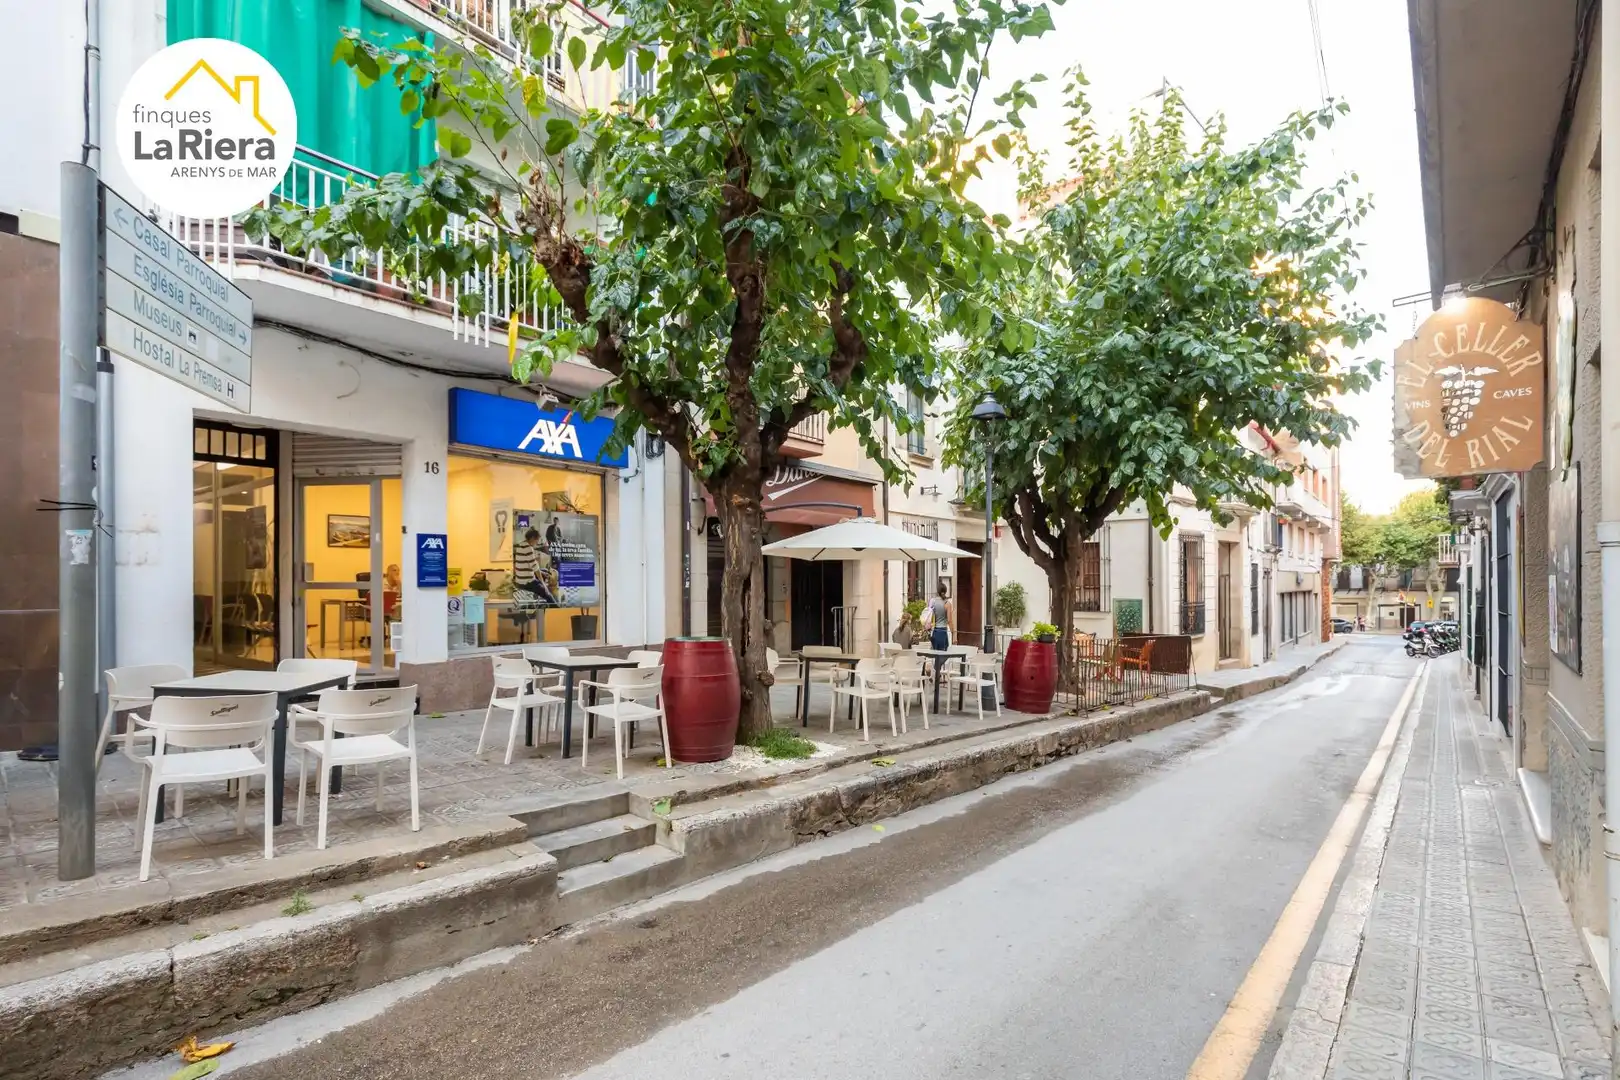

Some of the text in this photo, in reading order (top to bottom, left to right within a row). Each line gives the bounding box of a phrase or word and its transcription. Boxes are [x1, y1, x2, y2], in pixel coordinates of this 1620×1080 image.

[133, 216, 229, 302] Casal Parroquial
[133, 290, 183, 337] Museus
[189, 292, 236, 337] Parroquial
[133, 328, 174, 368] Hostal
[179, 353, 190, 377] La
[193, 361, 223, 393] Premsa
[1396, 322, 1543, 388] EL CELLER
[1404, 400, 1431, 411] VINS
[1493, 386, 1533, 400] CAVES
[517, 419, 583, 458] AXA
[1402, 415, 1534, 469] DEL RIAL
[424, 461, 440, 475] 16
[421, 538, 444, 549] AXA
